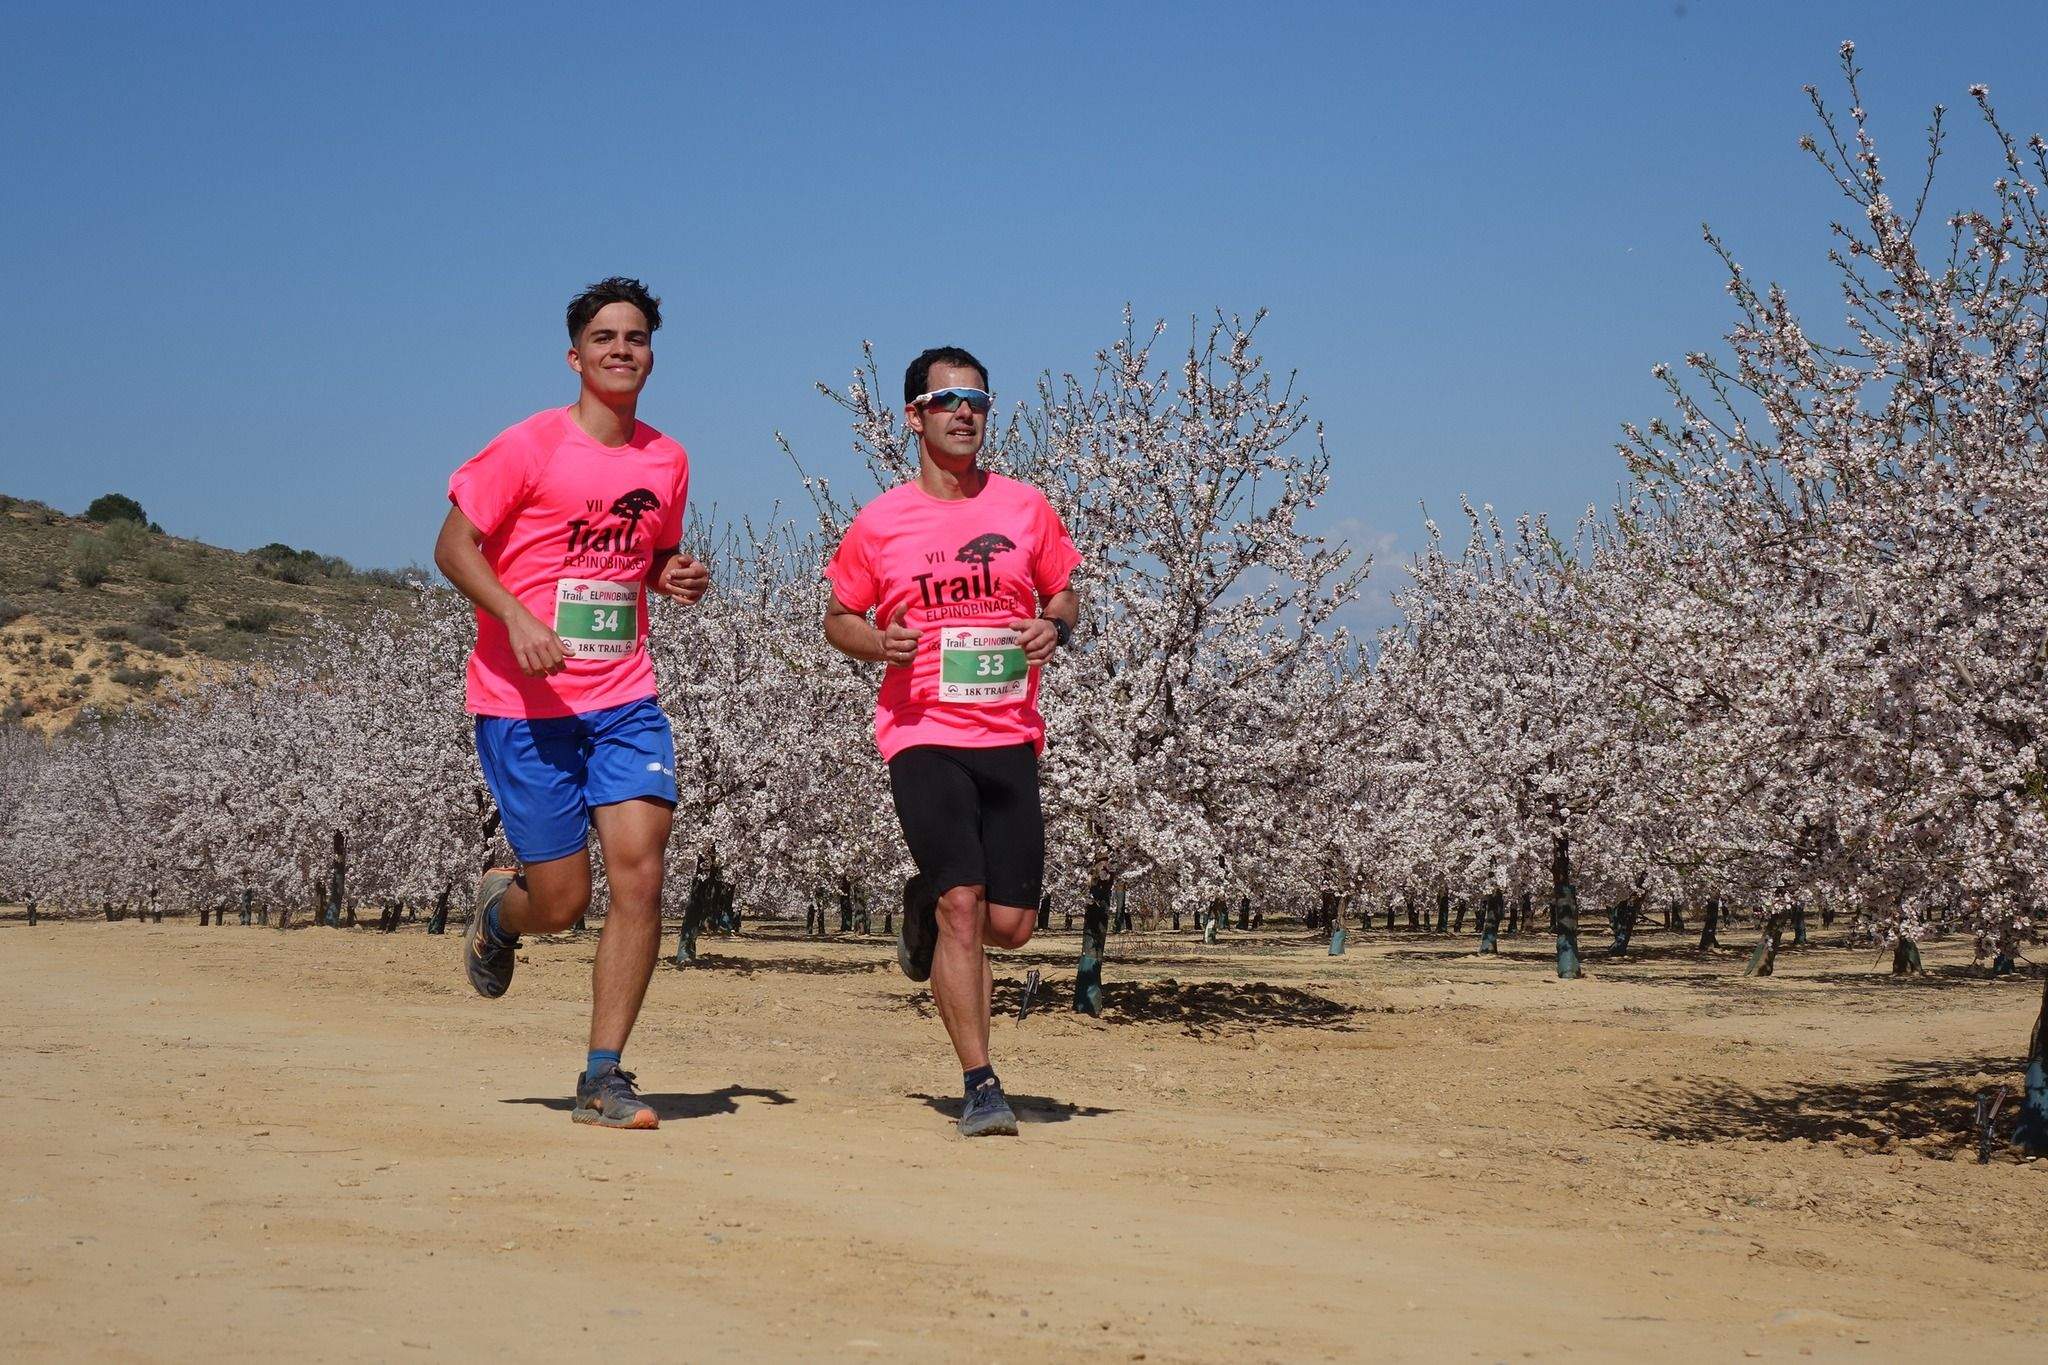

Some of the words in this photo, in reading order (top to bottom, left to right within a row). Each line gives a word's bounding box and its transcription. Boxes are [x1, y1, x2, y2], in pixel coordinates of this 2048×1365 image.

[586, 499, 603, 513] VII
[566, 518, 638, 555] Trail
[925, 551, 946, 565] VII
[912, 564, 994, 609] Trail
[562, 590, 582, 601] Trail
[591, 609, 619, 632] 34
[578, 643, 596, 653] 18K
[598, 644, 623, 653] TRAIL
[945, 638, 965, 648] Trail
[976, 654, 1005, 677] 33
[965, 688, 982, 696] 18K
[983, 686, 1009, 696] TRAIL
